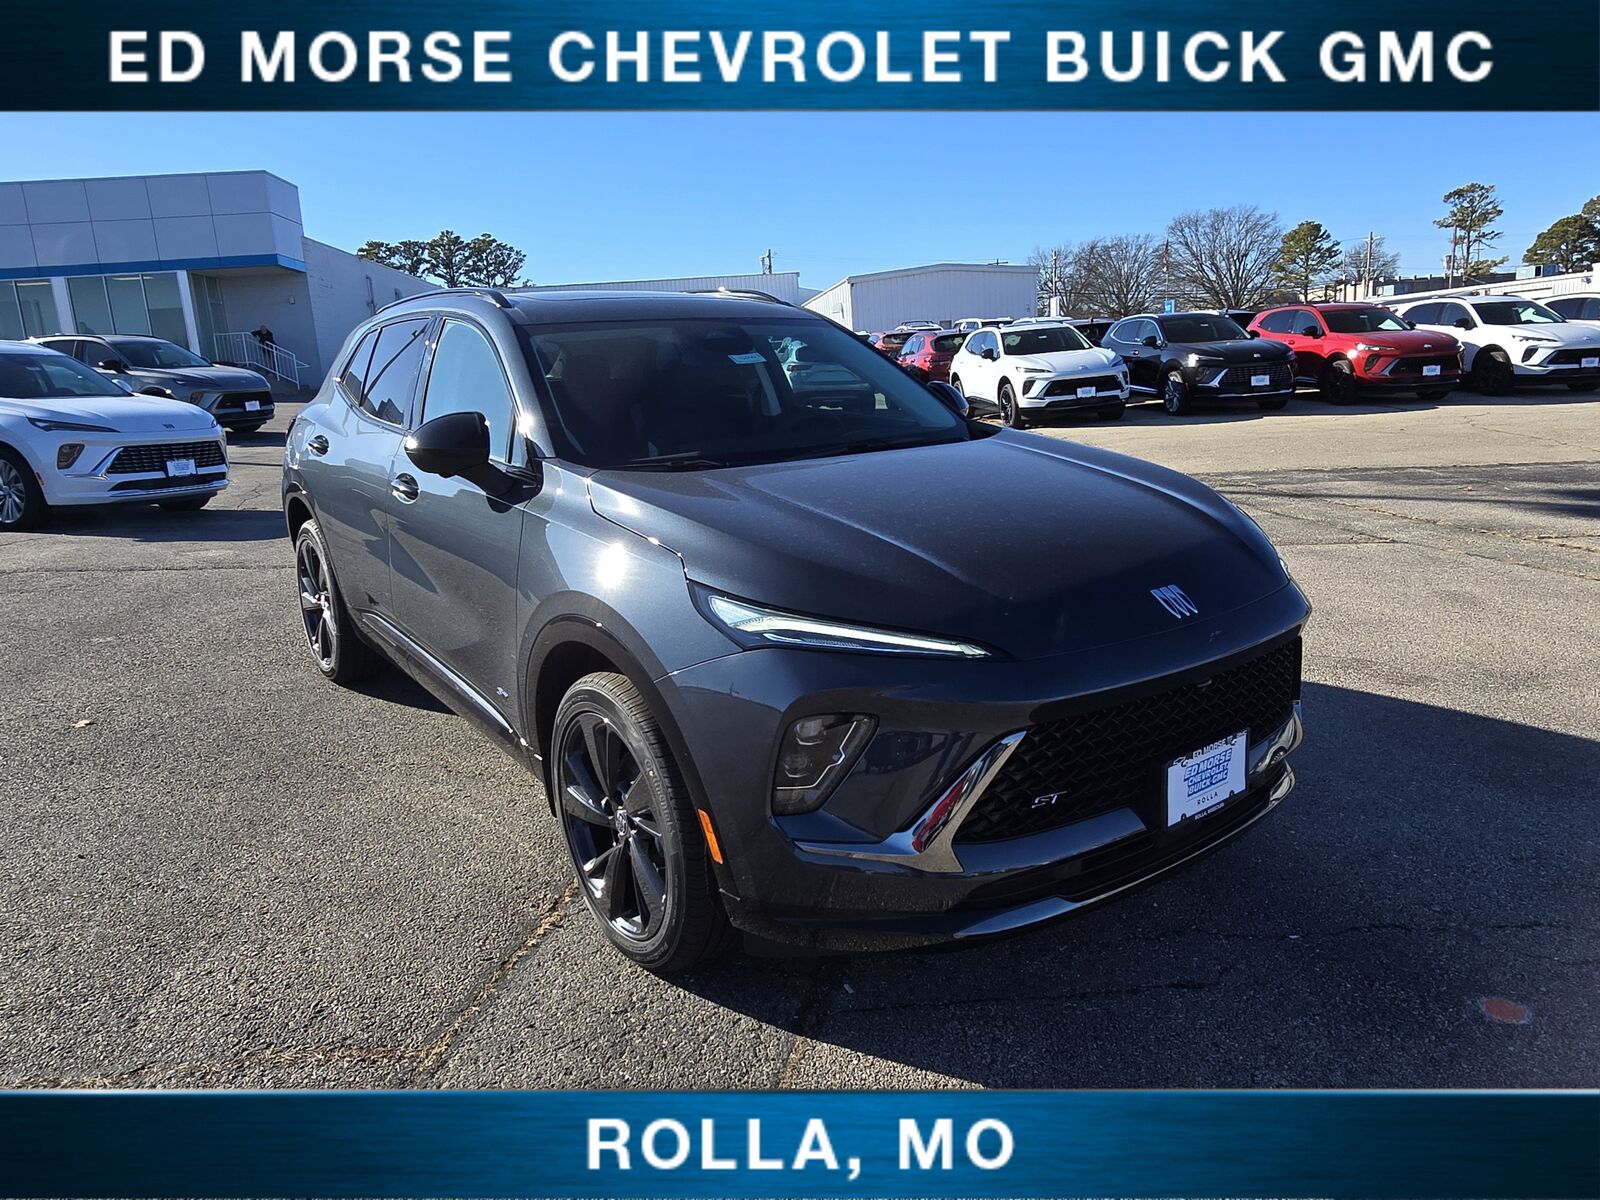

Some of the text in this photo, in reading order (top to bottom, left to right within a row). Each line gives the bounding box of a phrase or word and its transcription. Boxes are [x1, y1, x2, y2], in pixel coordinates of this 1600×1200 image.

[1184, 748, 1233, 779] ED MORSE
[1187, 762, 1229, 786] CHEVROLET
[1197, 791, 1218, 805] ROLLA
